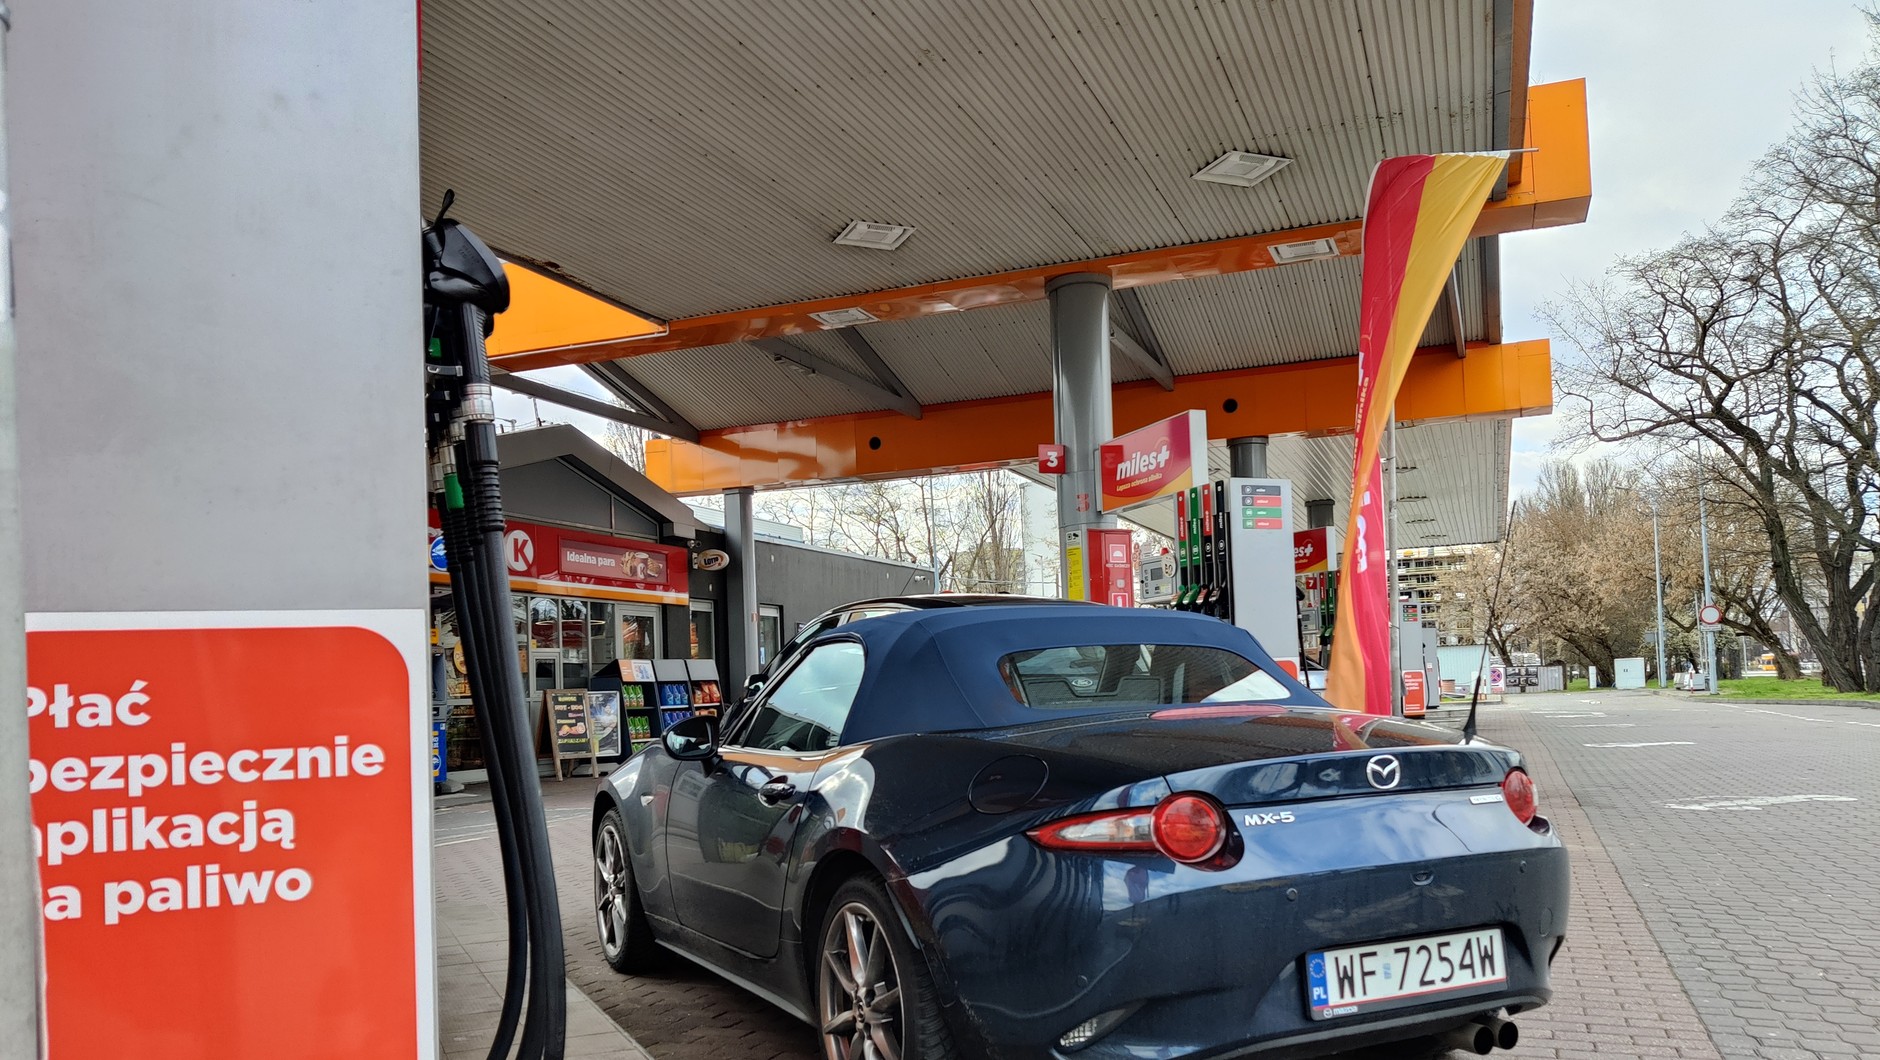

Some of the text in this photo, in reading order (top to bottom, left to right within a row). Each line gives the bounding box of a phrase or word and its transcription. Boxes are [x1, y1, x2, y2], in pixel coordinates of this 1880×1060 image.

[1046, 451, 1059, 468] 3
[1115, 444, 1170, 481] miles+
[513, 538, 532, 568] K
[566, 551, 616, 567] Idealna para
[1244, 811, 1296, 827] MX-5
[104, 864, 313, 925] paliwo
[1334, 935, 1497, 1000] WF 7254W
[1312, 986, 1327, 1000] PL
